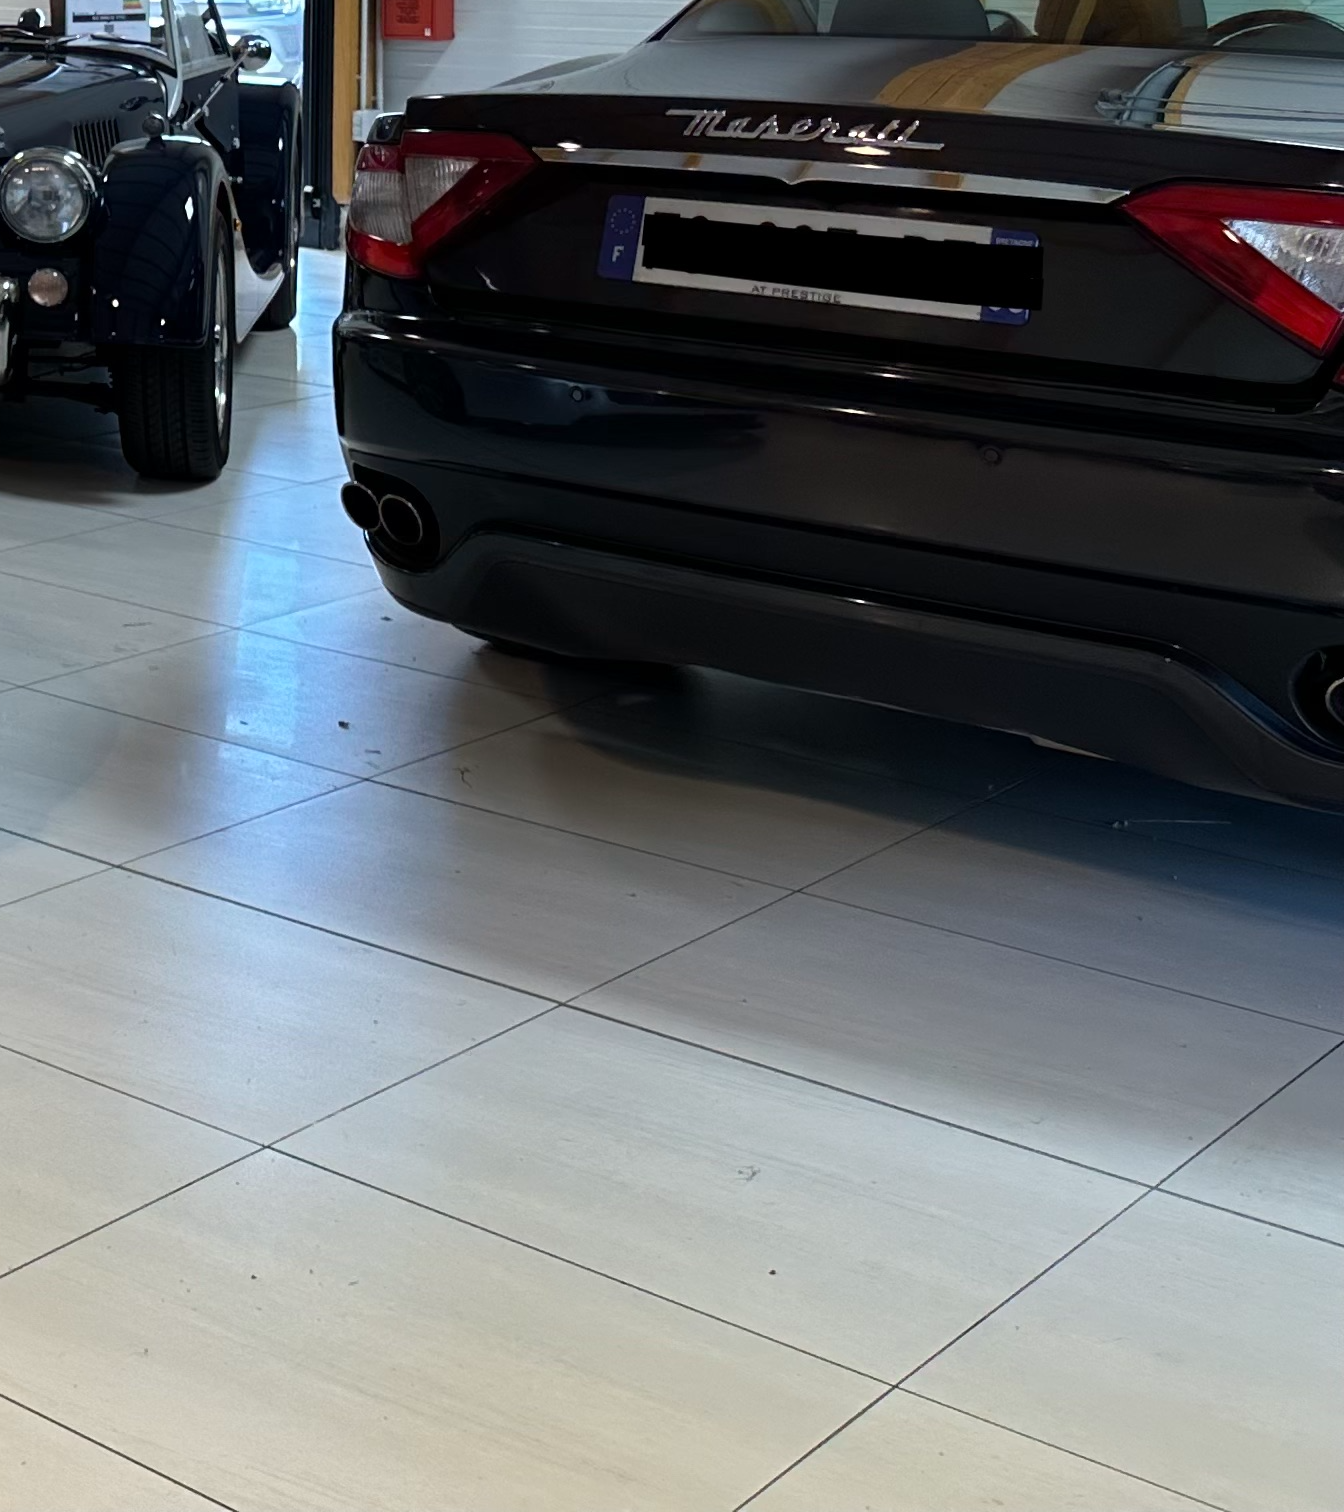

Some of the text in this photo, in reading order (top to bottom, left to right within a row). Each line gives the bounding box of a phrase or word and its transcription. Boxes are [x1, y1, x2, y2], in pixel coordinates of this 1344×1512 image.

[665, 109, 945, 150] Maserati
[612, 245, 624, 262] F
[751, 285, 842, 305] AT PRESTIGE
